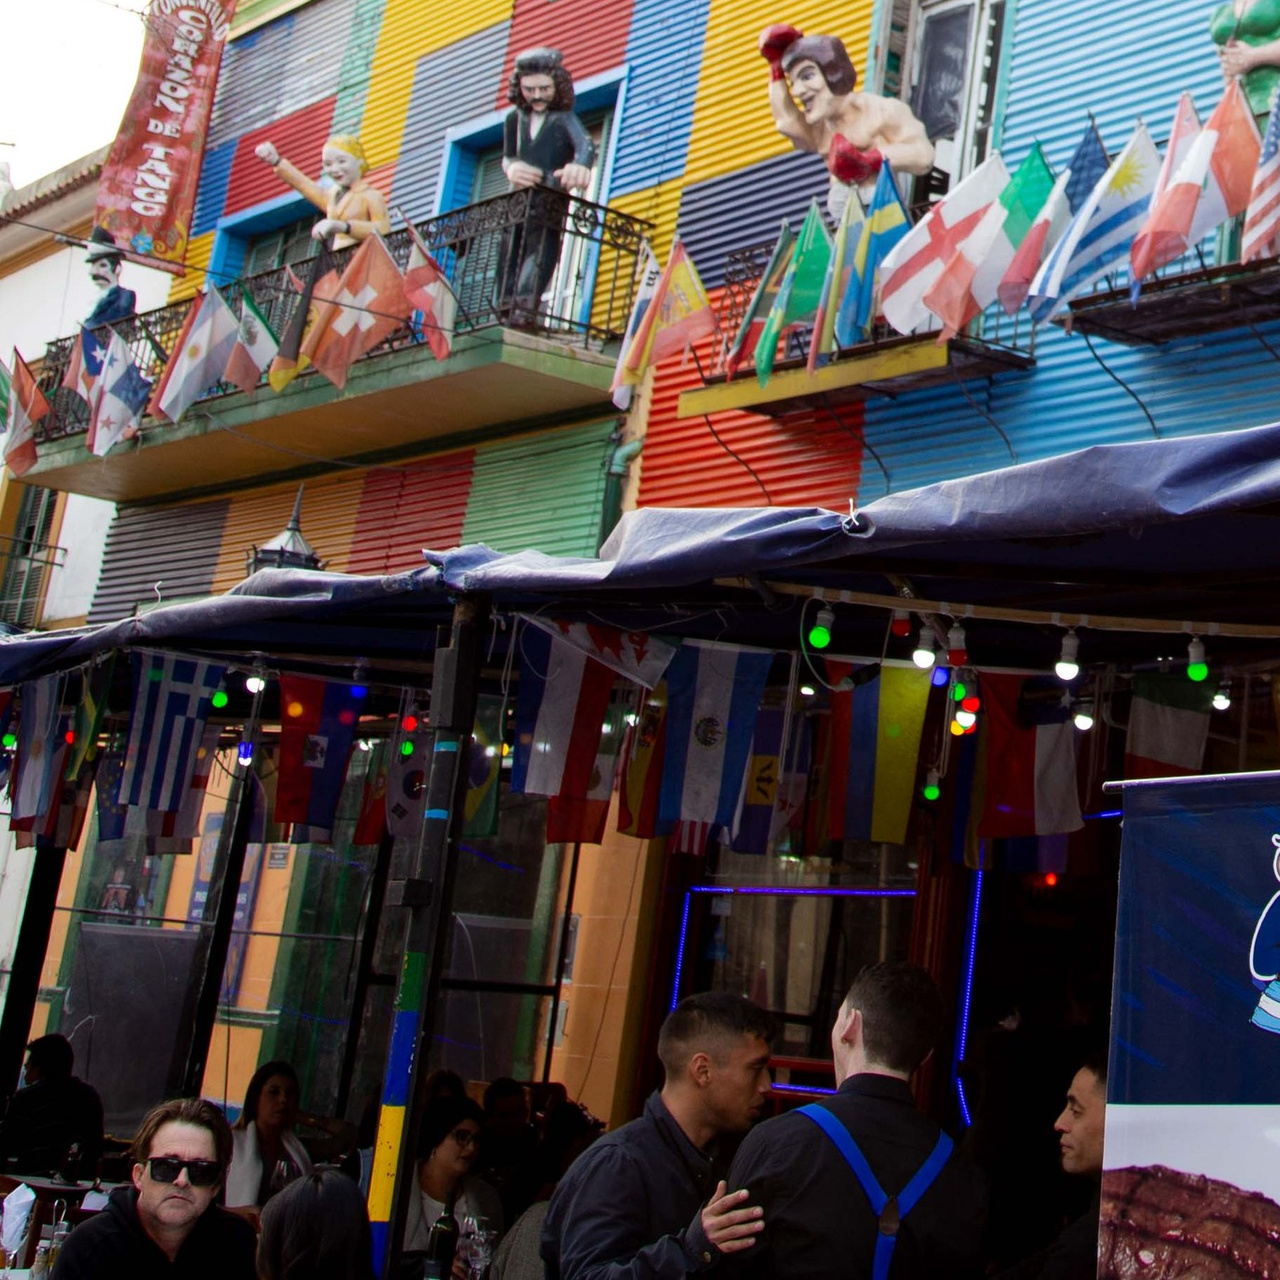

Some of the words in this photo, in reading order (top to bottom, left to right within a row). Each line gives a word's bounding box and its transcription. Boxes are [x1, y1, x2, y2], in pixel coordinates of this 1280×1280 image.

[154, 9, 208, 115] CORAZON
[147, 117, 181, 139] DE
[130, 142, 174, 218] TANGO
